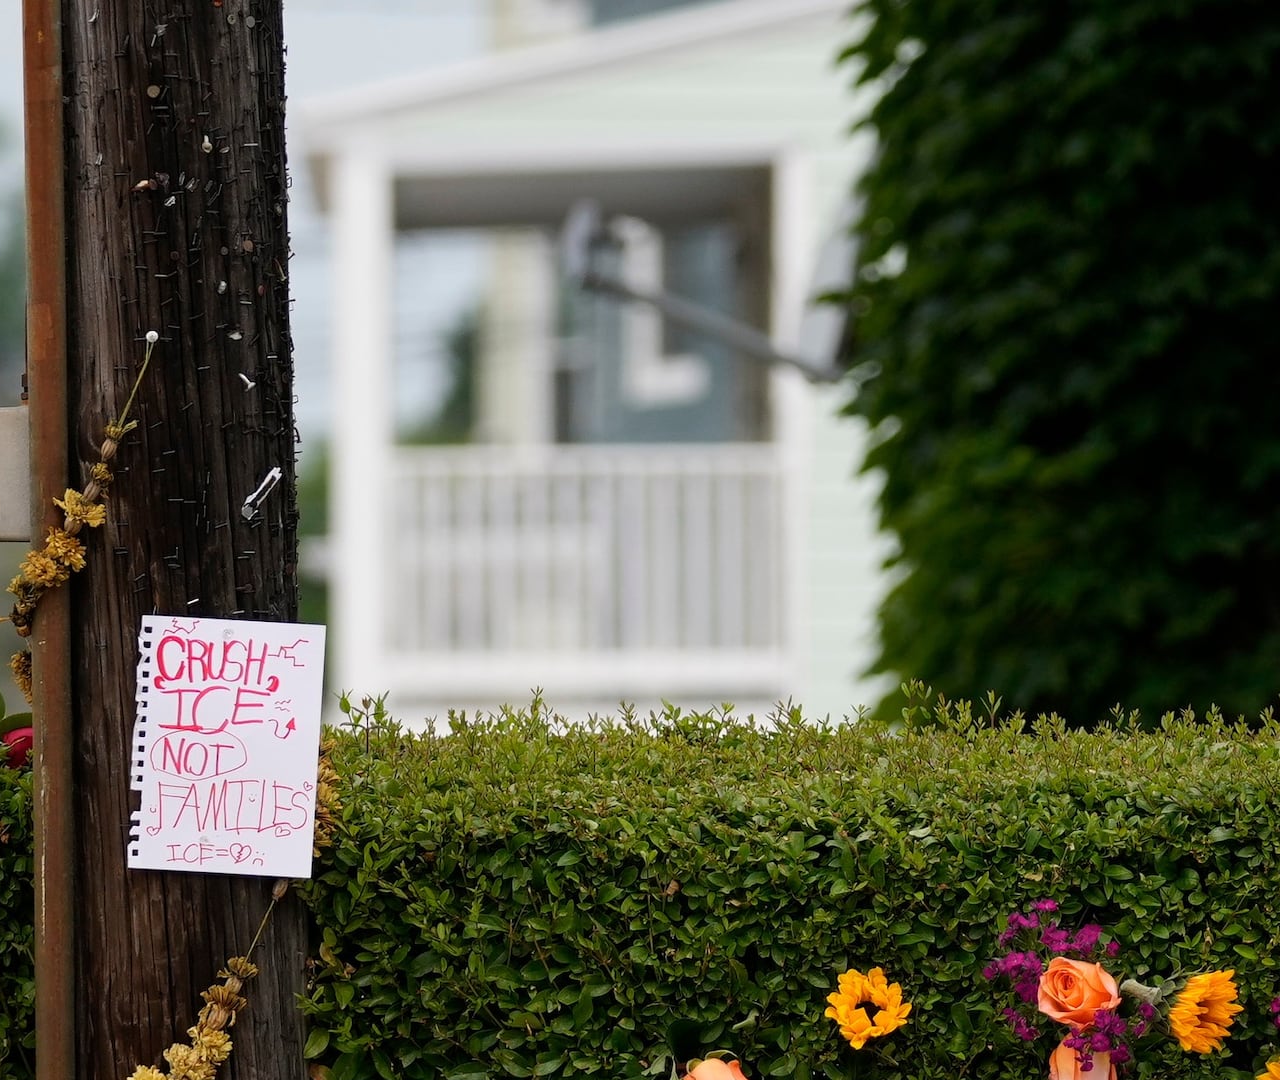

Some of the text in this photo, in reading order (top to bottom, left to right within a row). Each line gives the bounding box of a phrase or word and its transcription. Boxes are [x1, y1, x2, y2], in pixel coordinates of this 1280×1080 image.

[156, 635, 268, 685] CRUSH
[158, 686, 271, 734] ICE
[163, 737, 235, 776] NOT
